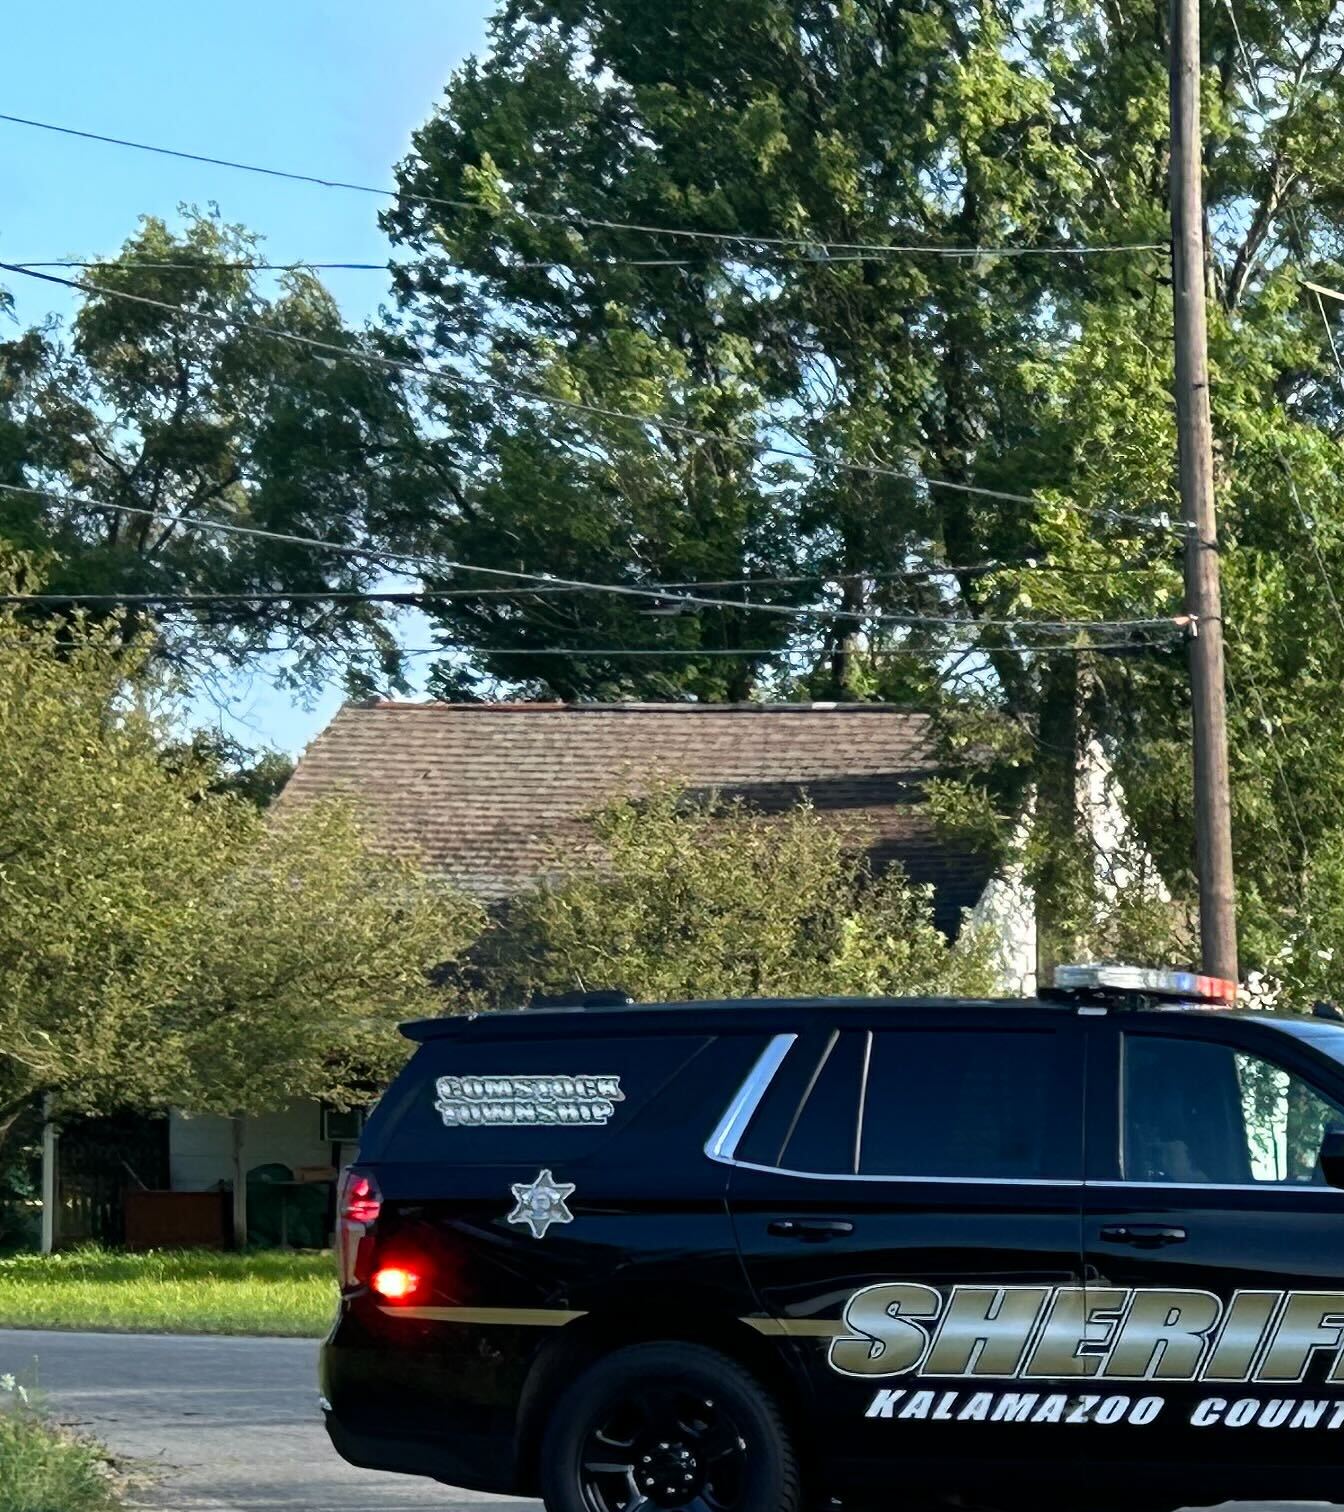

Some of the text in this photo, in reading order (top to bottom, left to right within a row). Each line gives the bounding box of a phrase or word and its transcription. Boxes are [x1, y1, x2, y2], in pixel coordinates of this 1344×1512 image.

[437, 1075, 625, 1101] COMSTOCK
[435, 1100, 614, 1126] TOWNSHIP
[865, 1388, 1165, 1426] KALAMAZOO
